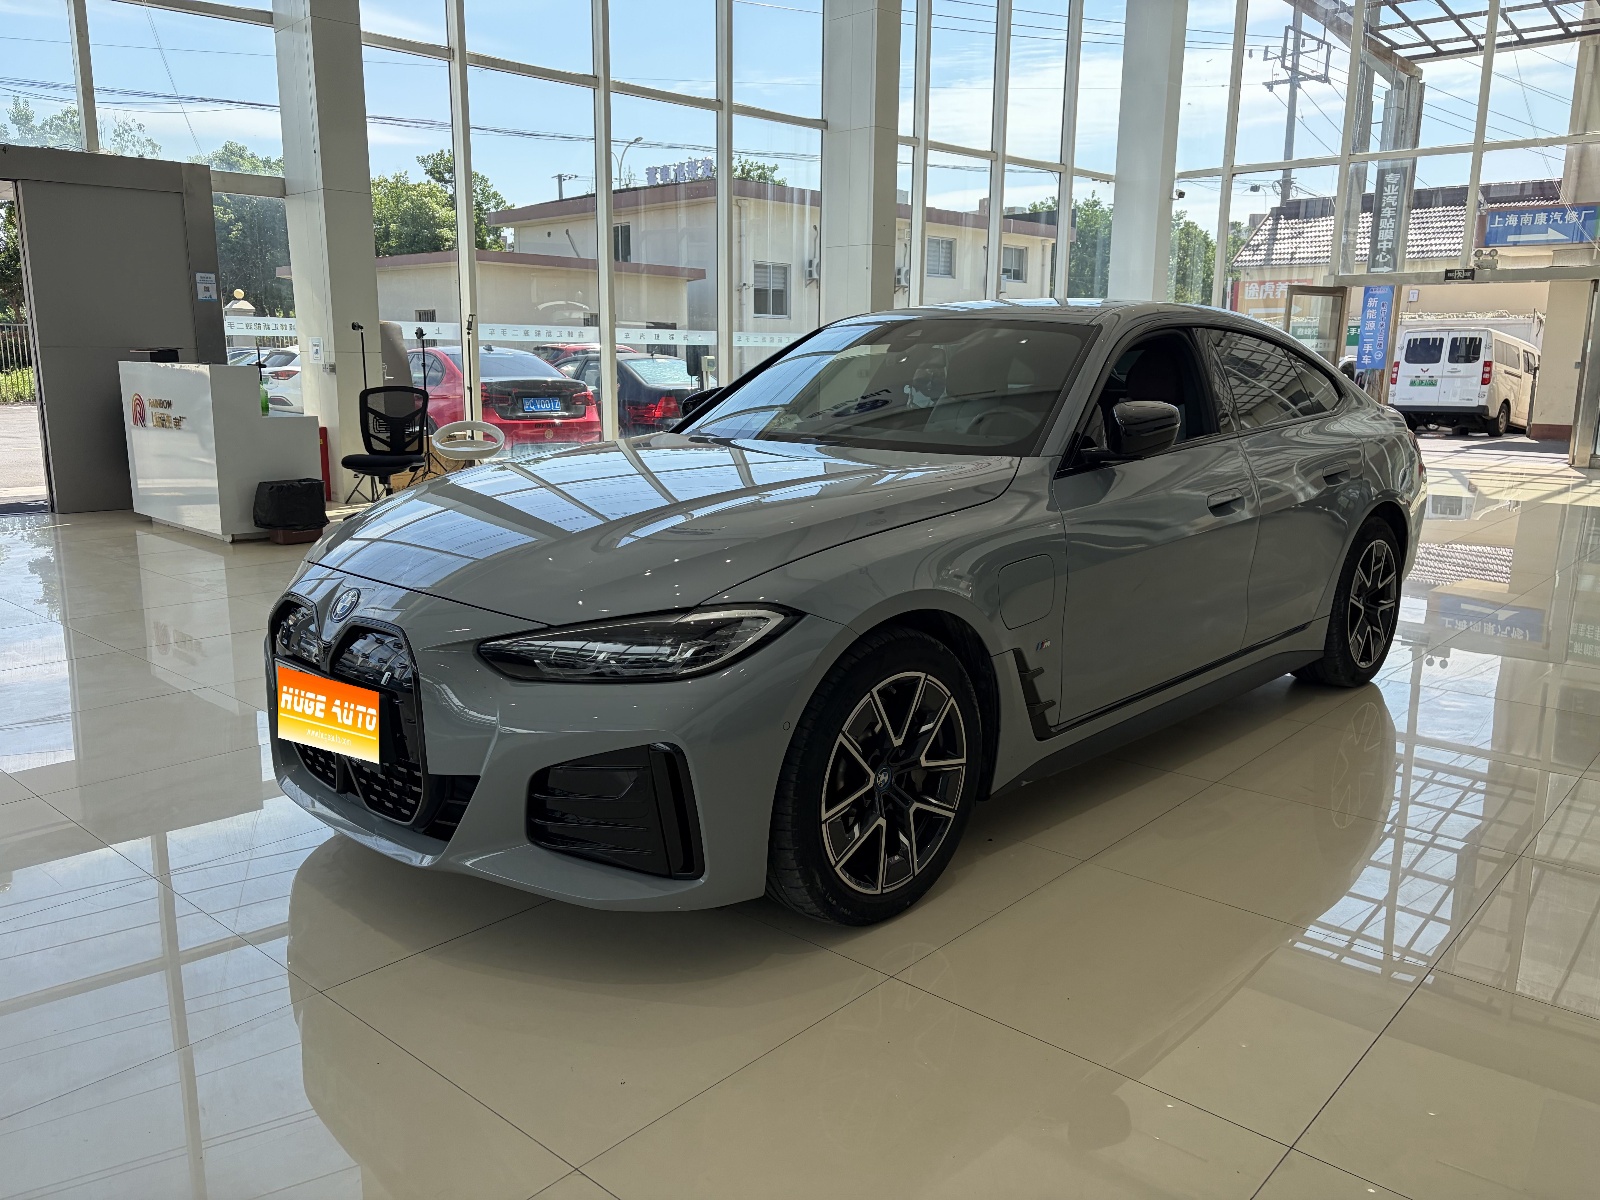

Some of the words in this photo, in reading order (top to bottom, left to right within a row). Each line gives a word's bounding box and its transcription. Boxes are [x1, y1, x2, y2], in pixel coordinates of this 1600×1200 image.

[1375, 172, 1401, 263] 专业汽车贴膜中心
[1490, 209, 1595, 228] 上海南康汽修厂
[1361, 297, 1379, 366] 新能源二手车
